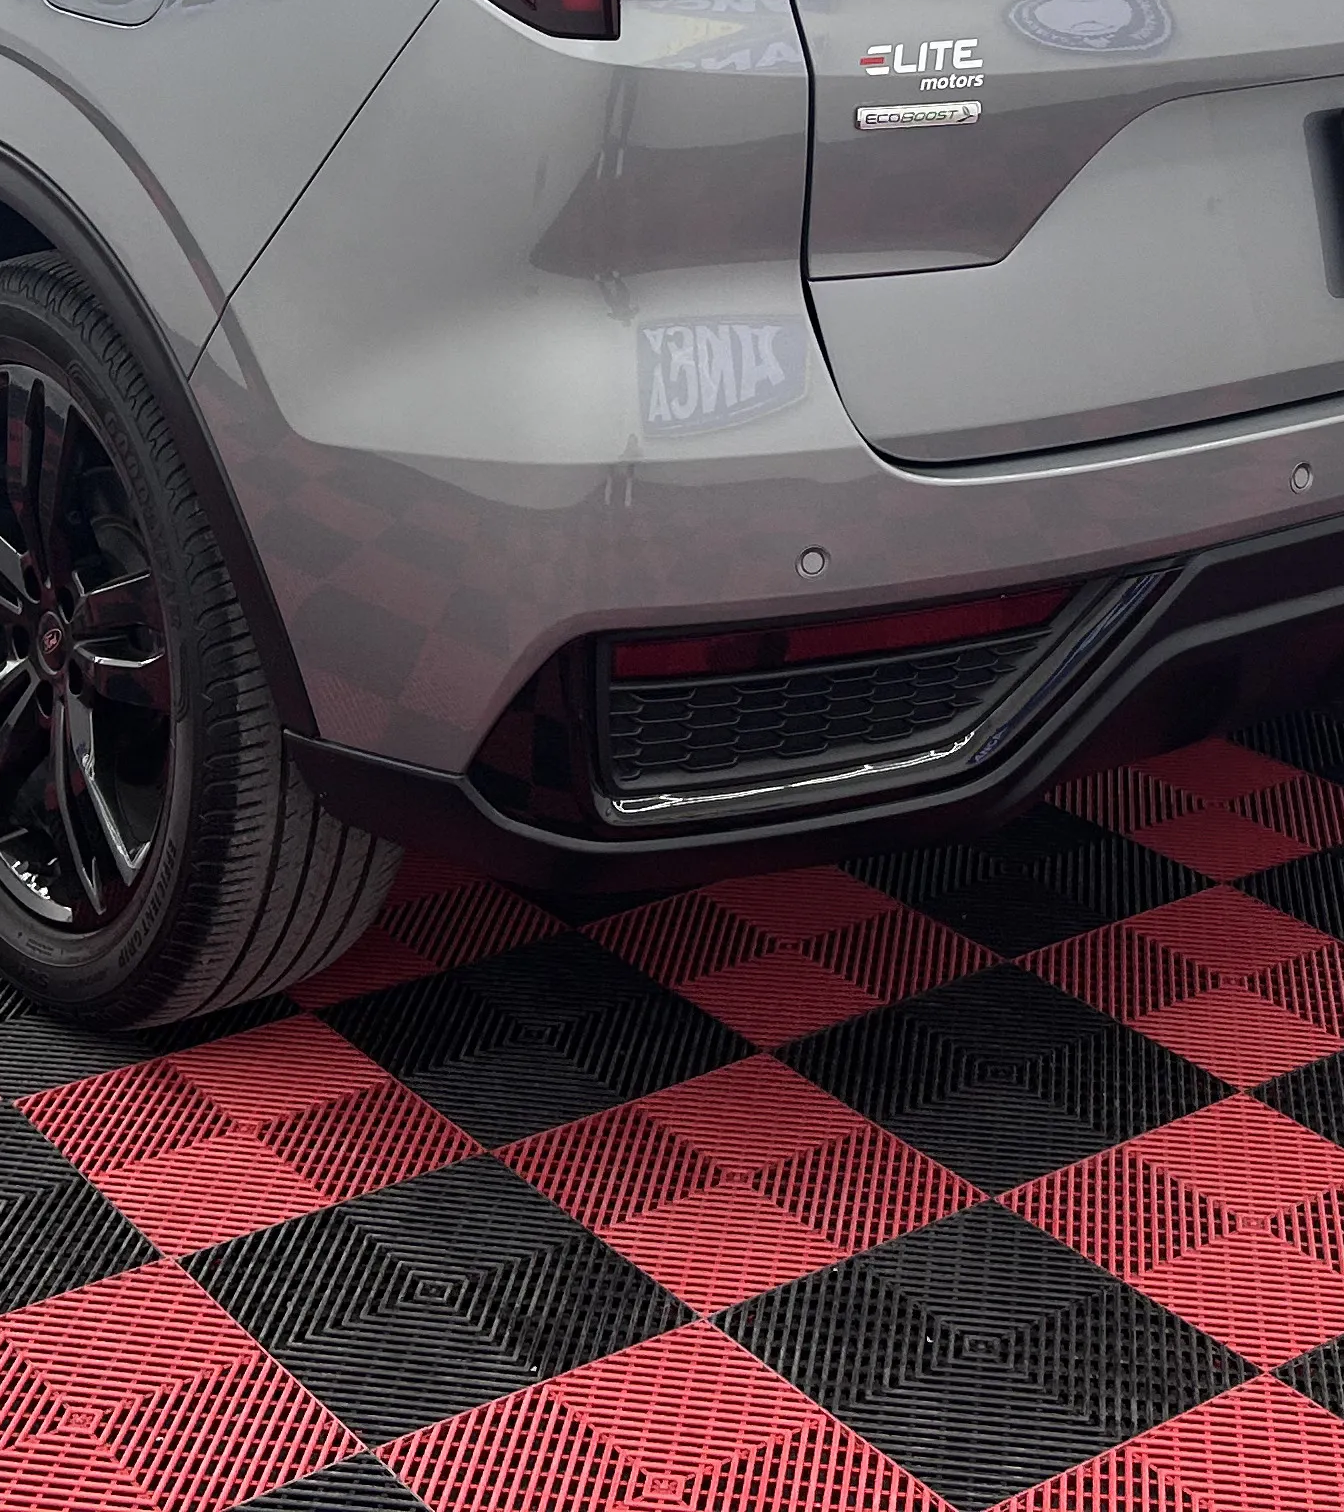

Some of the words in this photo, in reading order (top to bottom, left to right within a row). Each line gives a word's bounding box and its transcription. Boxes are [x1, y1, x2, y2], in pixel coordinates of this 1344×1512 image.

[859, 38, 983, 76] ELITE
[919, 73, 984, 91] motors
[864, 109, 959, 125] ECOBOOST
